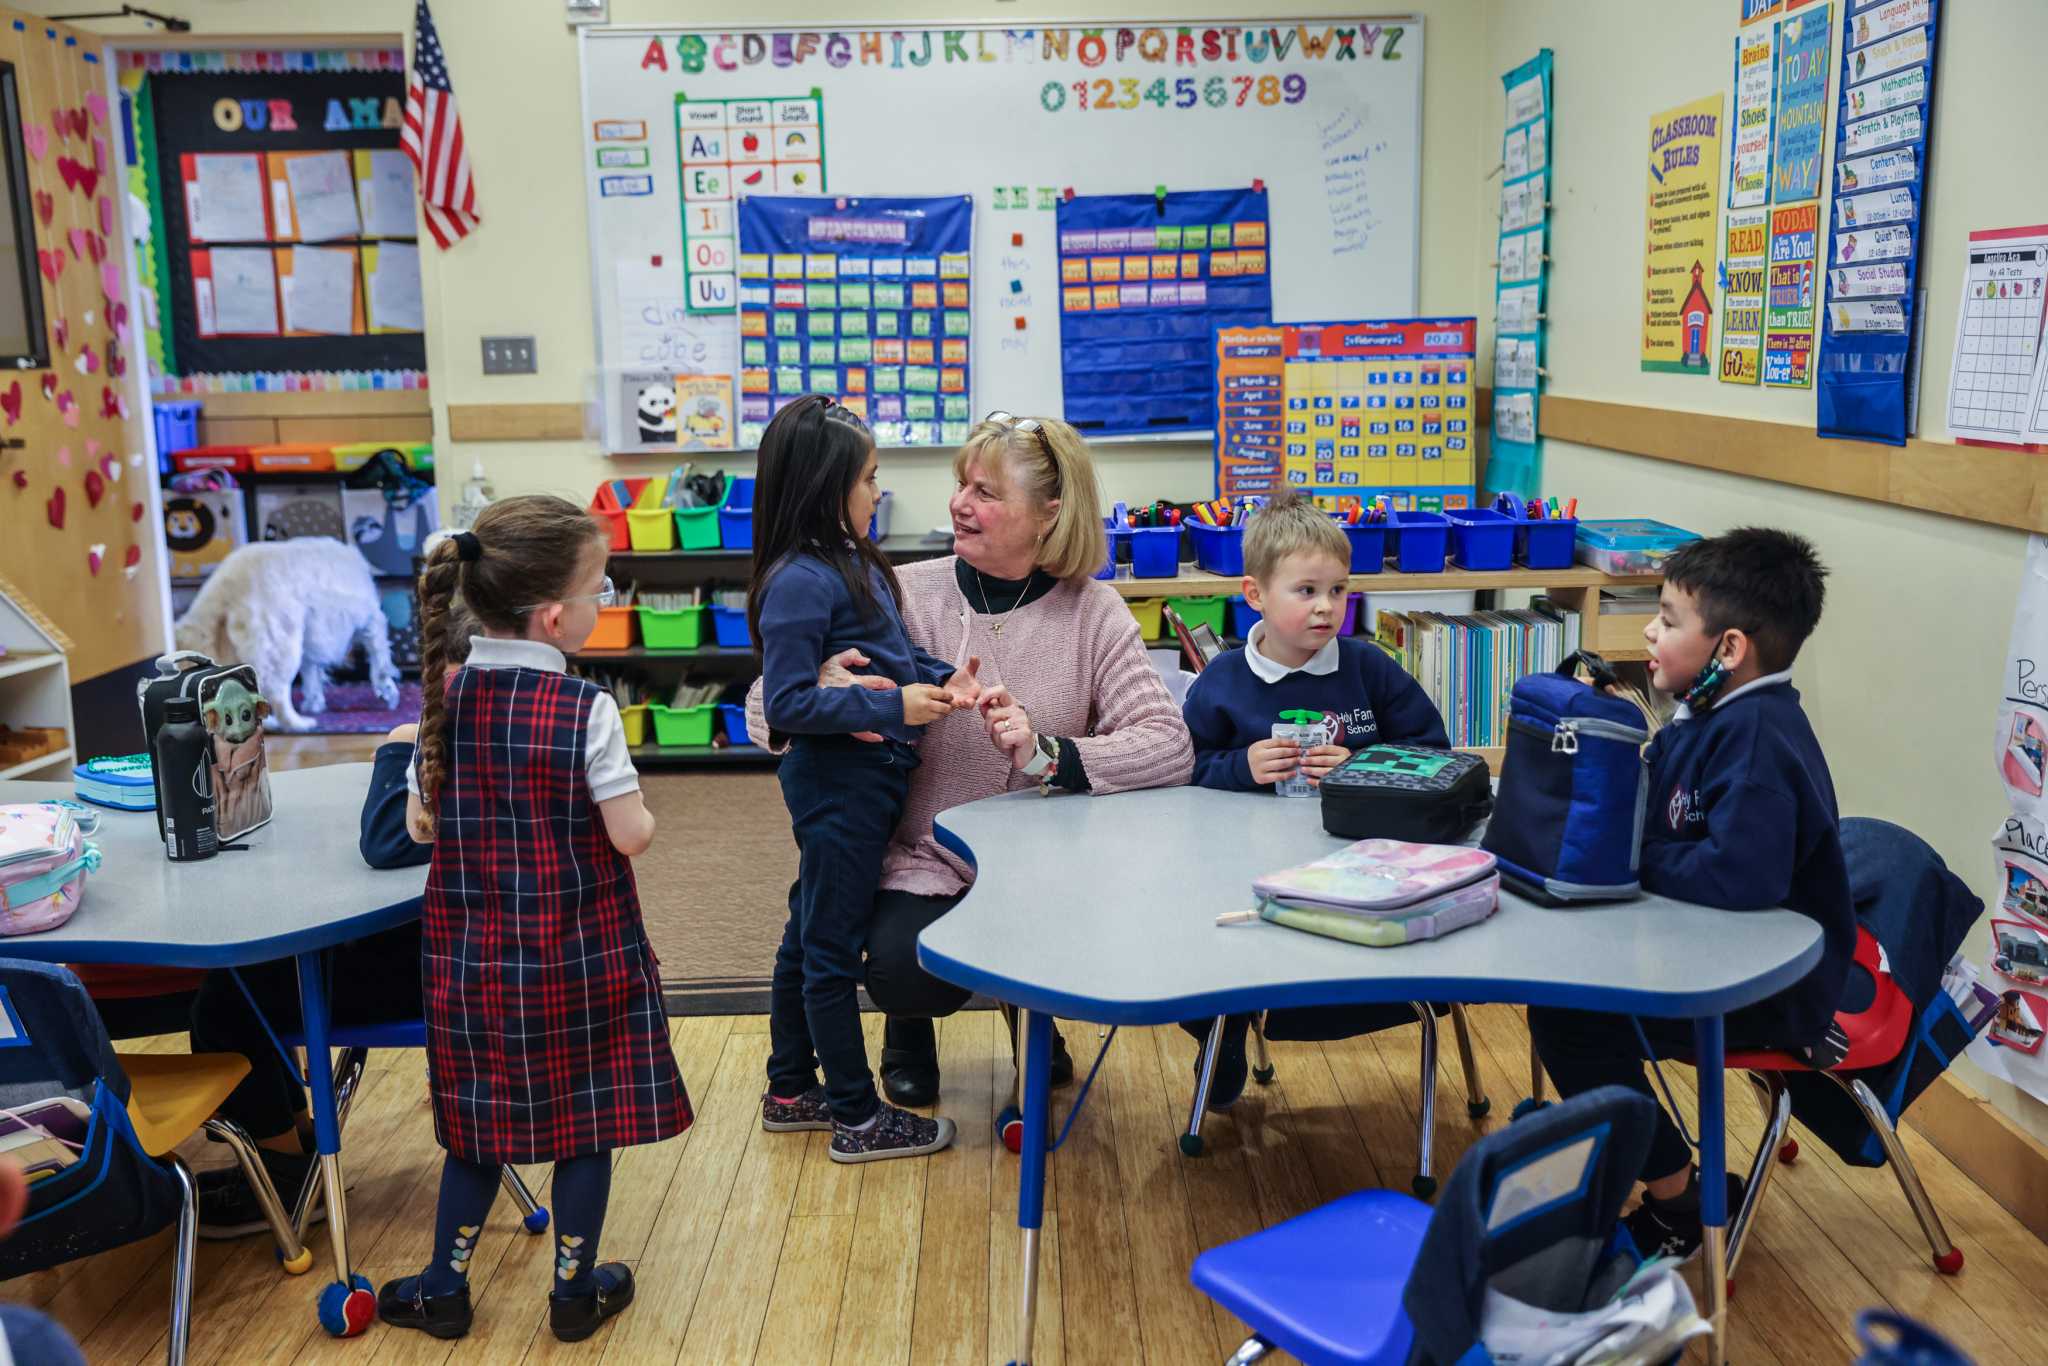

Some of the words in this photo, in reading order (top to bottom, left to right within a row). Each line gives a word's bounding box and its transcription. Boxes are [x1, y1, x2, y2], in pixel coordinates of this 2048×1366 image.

[1879, 1, 1910, 21] Language
[1742, 44, 1769, 65] Brains
[1785, 48, 1825, 84] TODAY
[1880, 70, 1924, 93] Mathematics
[213, 98, 297, 131] OUR
[689, 111, 718, 120] Vowel
[1741, 108, 1767, 127] Shoes
[1651, 113, 1717, 153] CLASSROOM
[1857, 117, 1881, 137] Stretch
[1883, 116, 1889, 129] &
[1663, 144, 1700, 175] RULES
[1870, 155, 1896, 170] Centers
[1896, 152, 1913, 166] Time
[695, 171, 719, 194] Ee
[1889, 191, 1911, 205] Lunch
[1773, 206, 1815, 235] TODAY
[1874, 231, 1892, 244] Quiet
[1893, 228, 1910, 240] Time
[696, 244, 725, 266] Oo
[1773, 242, 1790, 261] Are
[1790, 233, 1815, 259] You!
[1771, 267, 1791, 286] That
[1792, 267, 1799, 284] is
[1857, 269, 1877, 282] Social
[1879, 267, 1904, 279] Studies
[2006, 267, 2022, 277] Tests
[700, 280, 726, 302] Uu
[1769, 311, 1786, 327] than
[1786, 308, 1812, 328] TRUE!
[1870, 303, 1902, 315] Dismissal
[1354, 335, 1392, 347] February
[1767, 337, 1783, 349] There
[1237, 346, 1270, 357] January
[1723, 350, 1744, 376] GO.
[1240, 376, 1265, 387] March
[1243, 390, 1263, 402] April
[1423, 397, 1436, 408] 10
[1450, 397, 1461, 407] 11
[1244, 406, 1261, 417] May
[1243, 421, 1262, 431] June
[1290, 423, 1301, 433] 12
[1318, 415, 1331, 425] 13
[1344, 426, 1357, 437] 14
[1373, 424, 1386, 434] 15
[1397, 421, 1411, 432] 16
[1425, 423, 1438, 434] 17
[1450, 421, 1462, 432] 18
[1246, 435, 1262, 446] July
[1290, 445, 1302, 456] 19
[1317, 448, 1333, 460] 20
[1343, 446, 1356, 457] 21
[1370, 446, 1385, 457] 22
[1398, 445, 1413, 456] 23
[1424, 448, 1439, 458] 24
[1448, 437, 1462, 449] 25
[1232, 464, 1274, 476] September
[1290, 471, 1305, 482] 26
[1318, 471, 1332, 482] 27
[1341, 473, 1356, 483] 28
[1236, 480, 1270, 490] October
